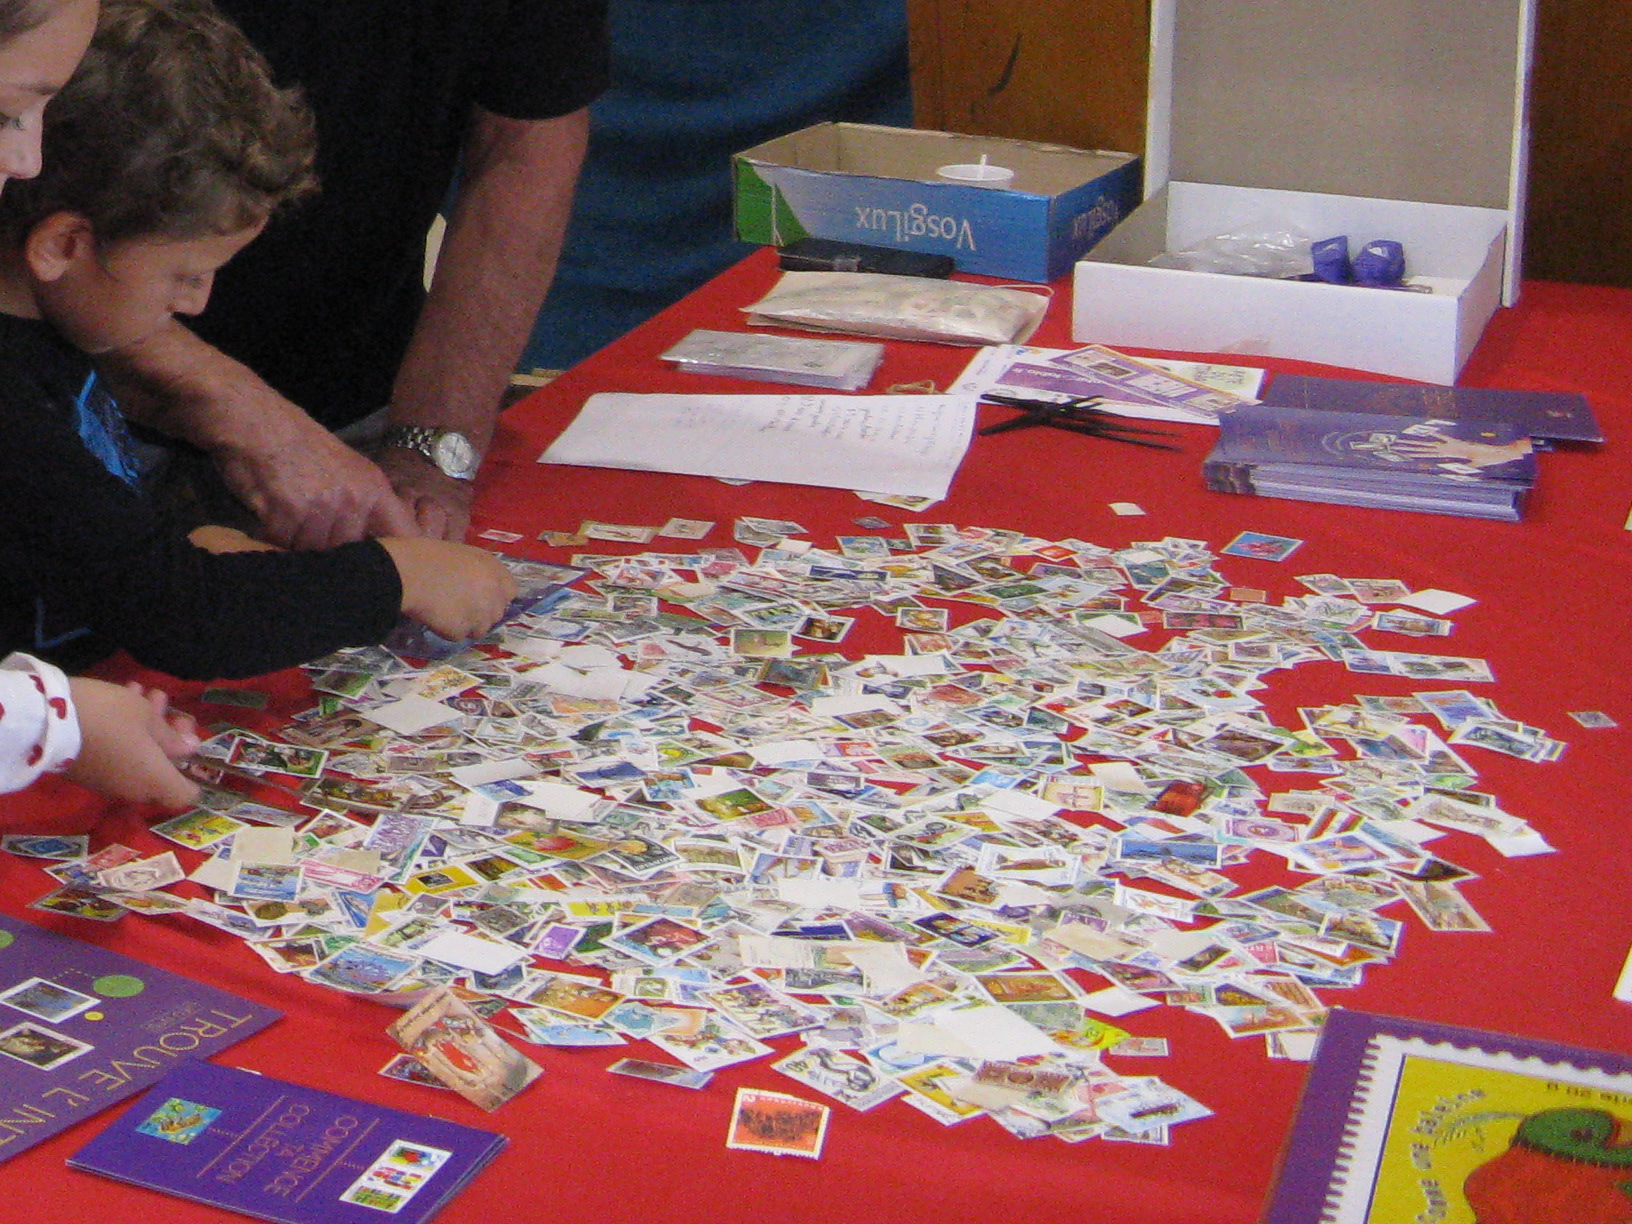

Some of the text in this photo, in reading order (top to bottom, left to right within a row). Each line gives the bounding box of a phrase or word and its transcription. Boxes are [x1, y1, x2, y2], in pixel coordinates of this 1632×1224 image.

[854, 202, 977, 251] VosgiLux
[78, 1009, 253, 1091] TROUVE
[216, 1104, 310, 1184] COLLECTION
[264, 1115, 358, 1197] COMMENCE
[277, 1143, 305, 1158] TA
